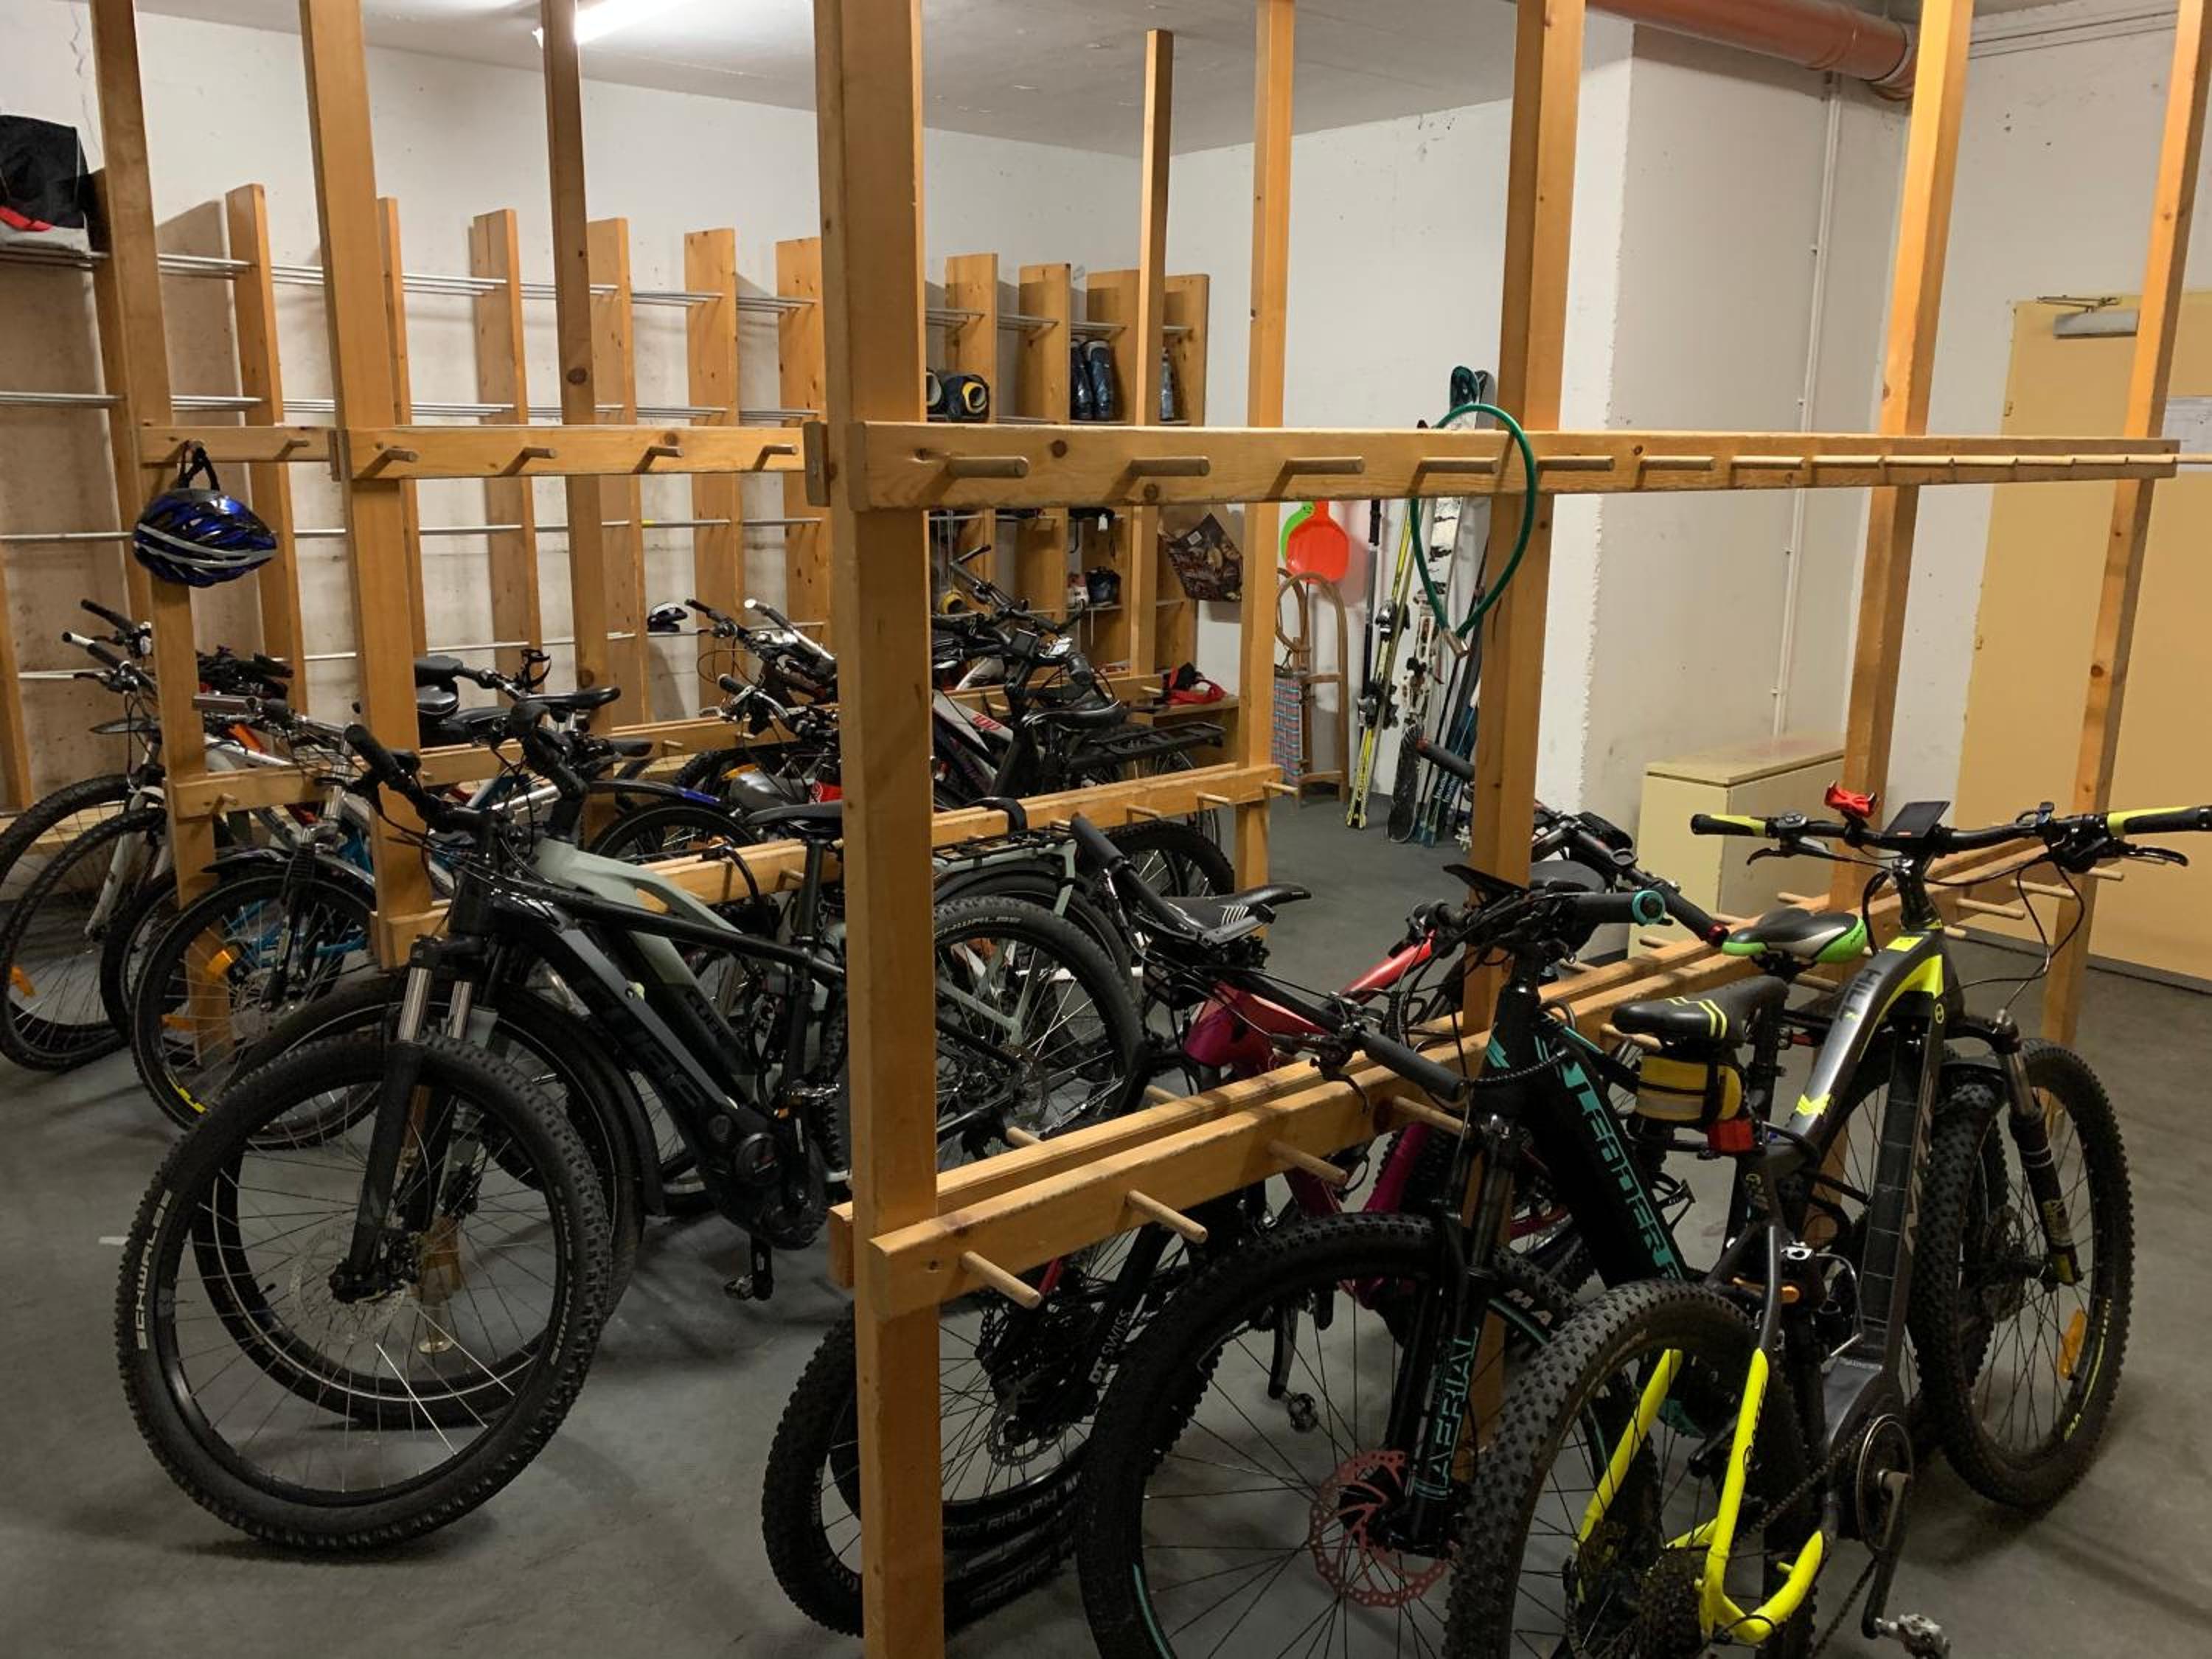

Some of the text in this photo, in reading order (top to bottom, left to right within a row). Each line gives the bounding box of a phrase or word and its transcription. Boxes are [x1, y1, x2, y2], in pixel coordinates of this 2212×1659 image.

[1572, 1079, 1669, 1259] LEADER
[136, 1188, 172, 1350] SCHWALBE
[1087, 1310, 1130, 1383] DT SWISS
[1427, 1327, 1478, 1489] AERIAL
